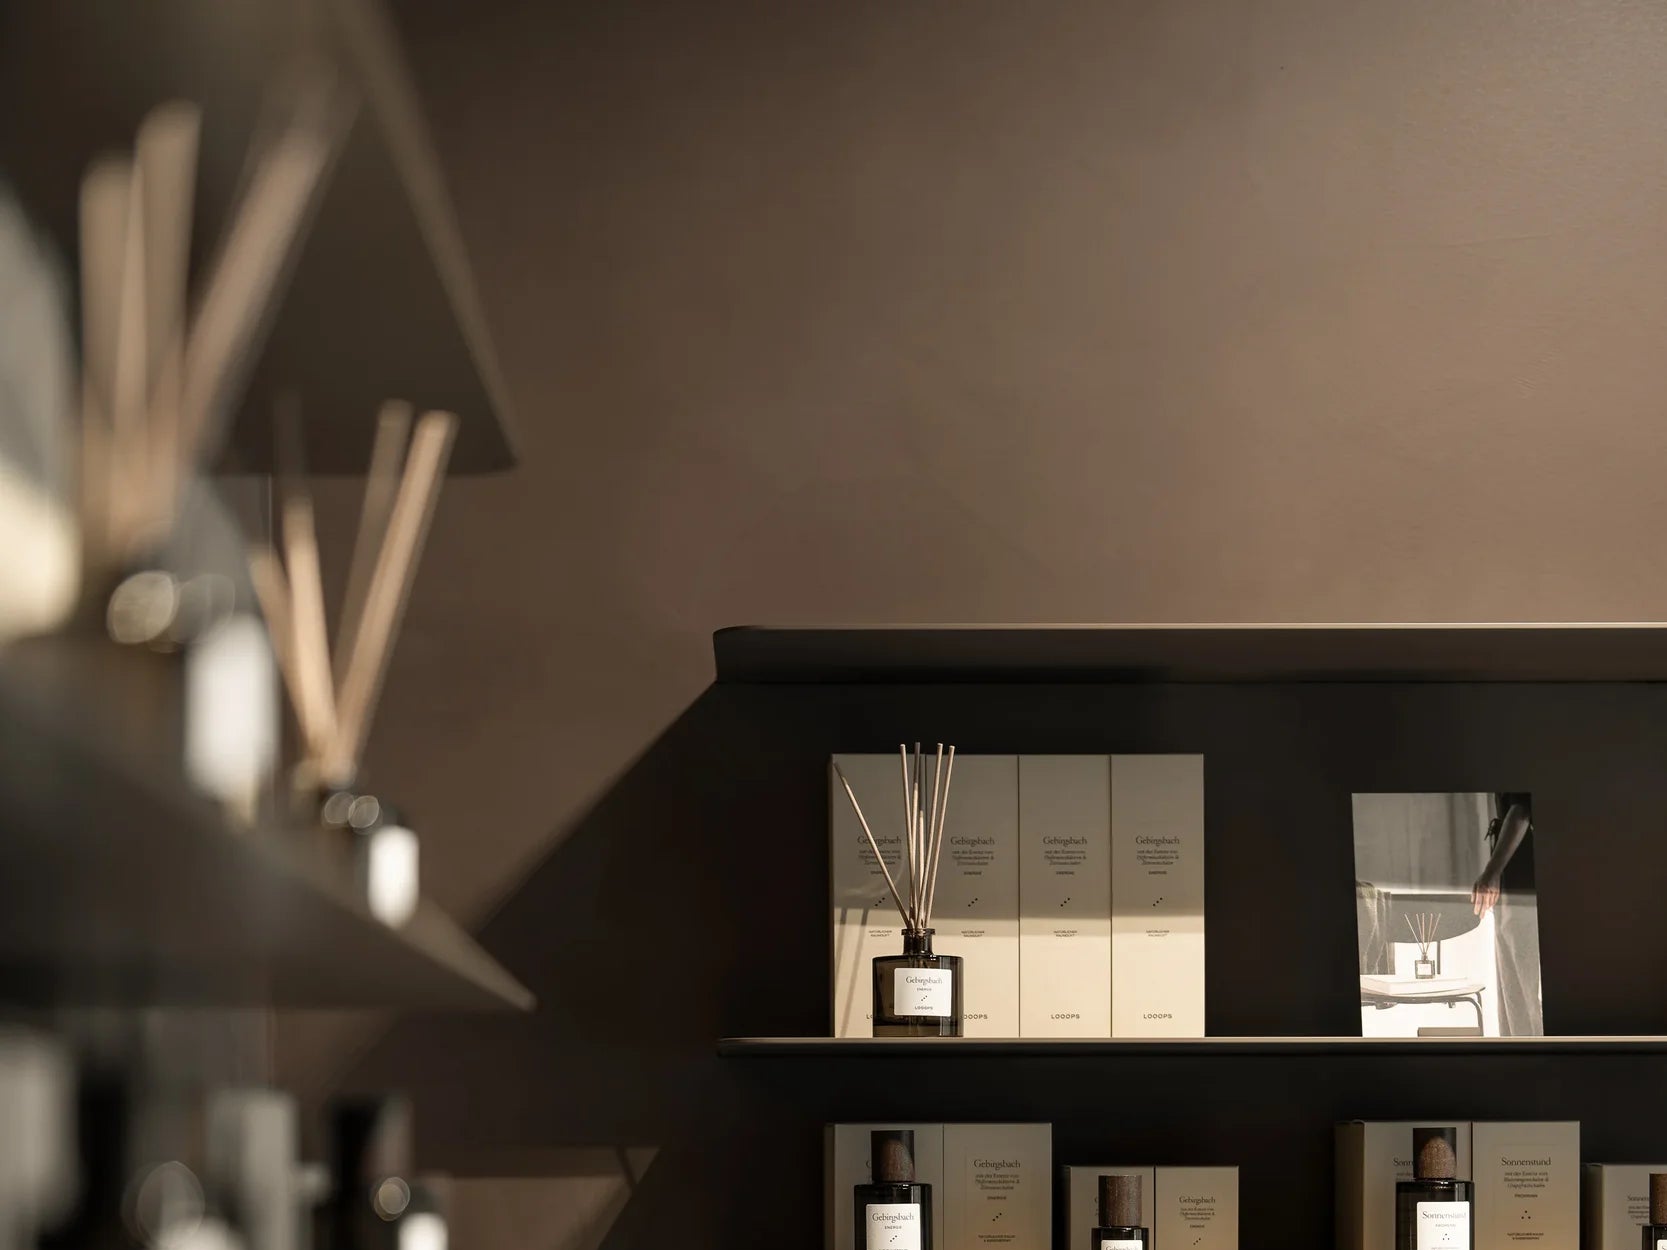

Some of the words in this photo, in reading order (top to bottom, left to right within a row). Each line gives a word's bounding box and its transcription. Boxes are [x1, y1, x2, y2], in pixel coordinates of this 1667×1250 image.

[951, 836, 996, 847] Gebirgsbach
[1043, 836, 1088, 847] Gebirgsbach
[1136, 835, 1181, 847] Gebirgsbach
[905, 976, 942, 987] Gebirgsbach
[974, 1160, 1021, 1171] Gebirgsbach
[1500, 1157, 1551, 1167] Sonnenstund
[1179, 1196, 1216, 1207] Gebirgsbach
[872, 1212, 914, 1224] Gebirgsbach
[1422, 1211, 1467, 1219] Sonnenstund
